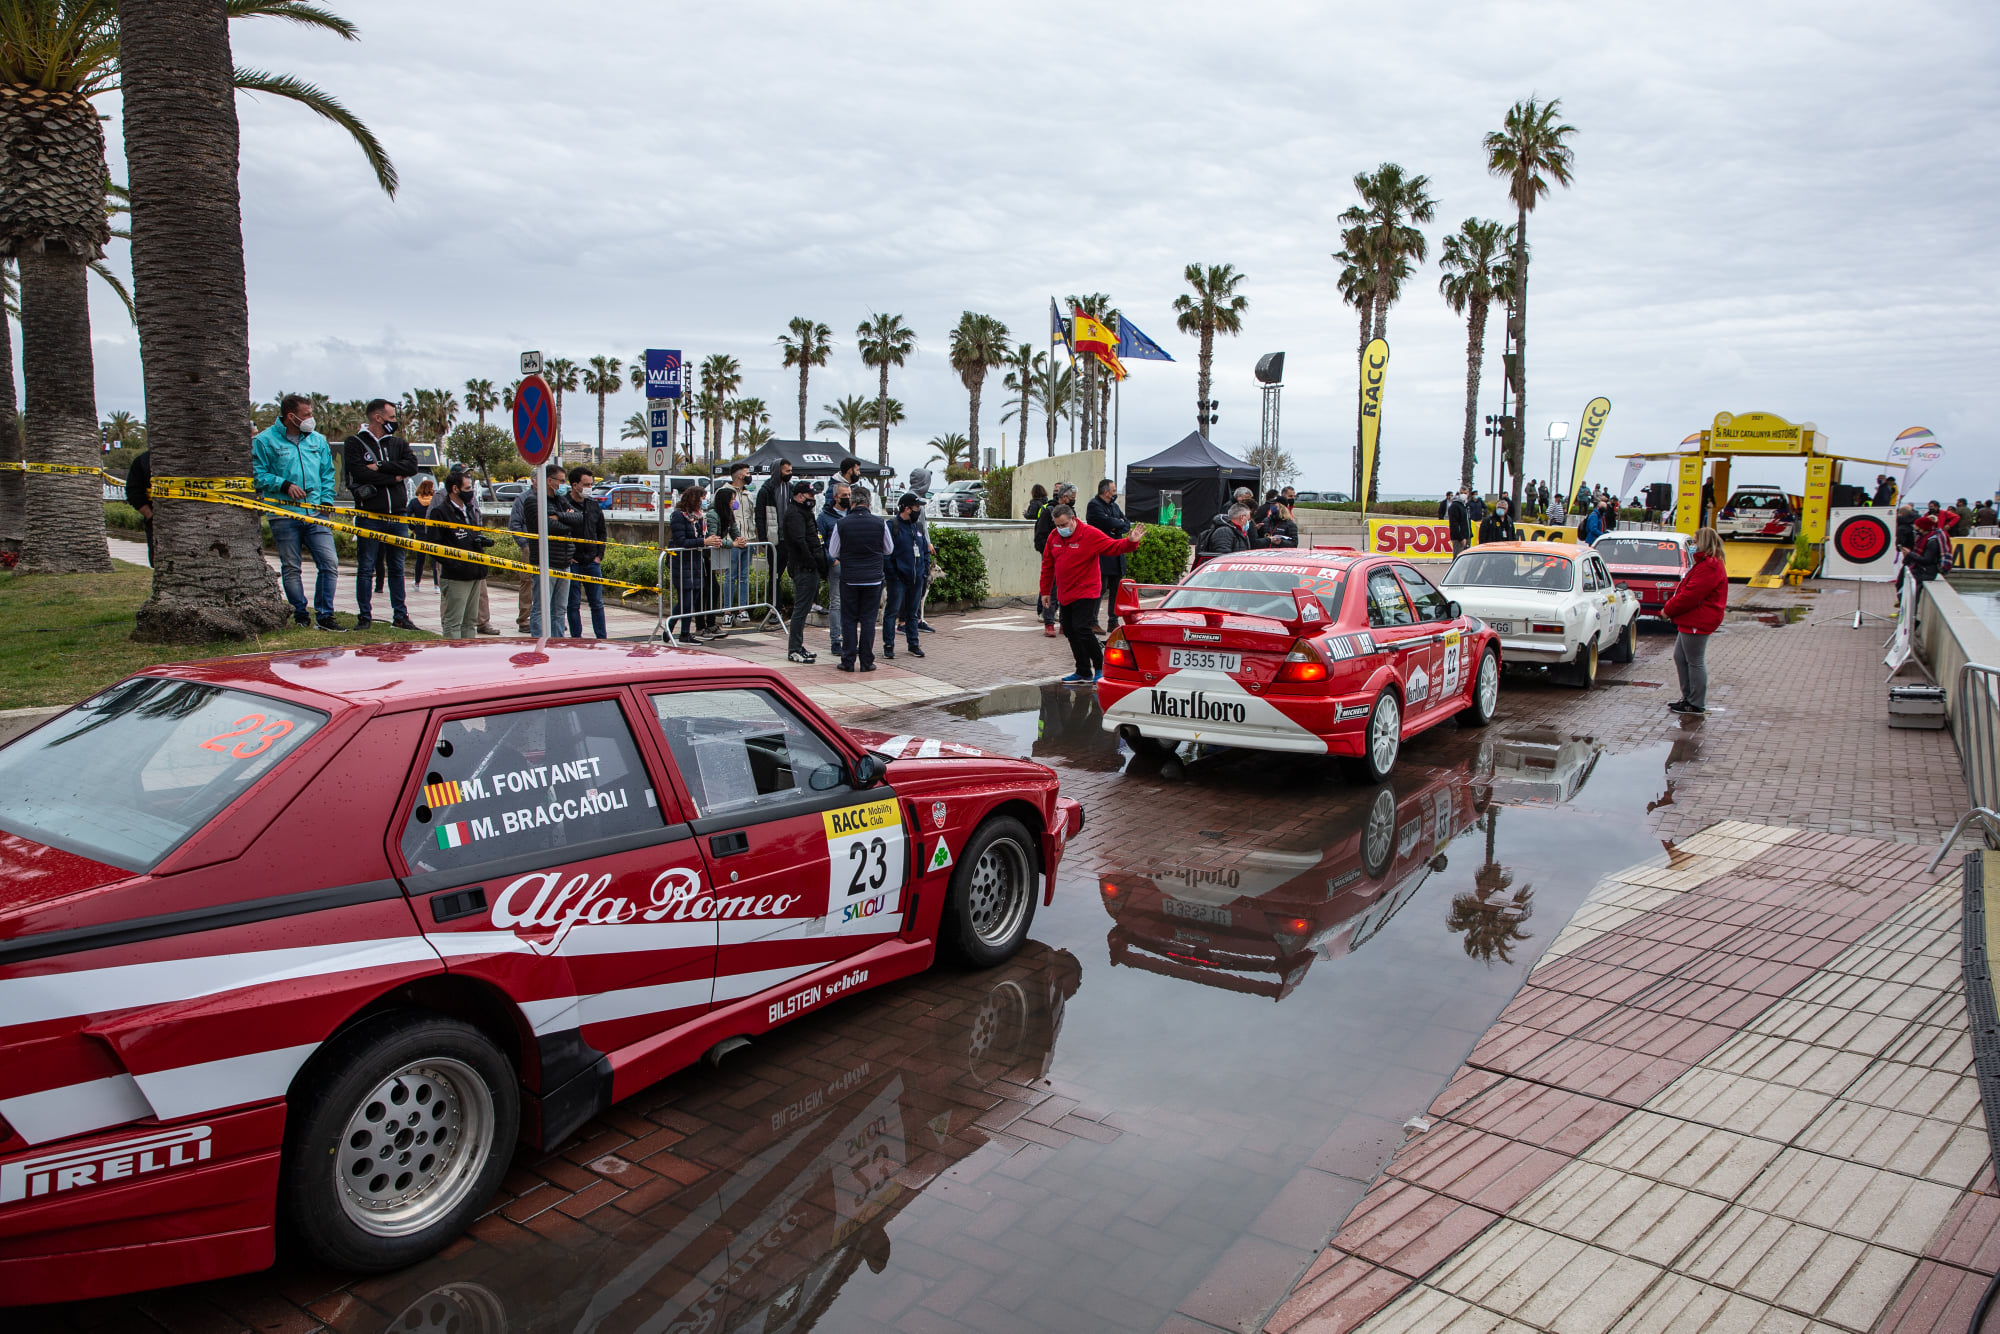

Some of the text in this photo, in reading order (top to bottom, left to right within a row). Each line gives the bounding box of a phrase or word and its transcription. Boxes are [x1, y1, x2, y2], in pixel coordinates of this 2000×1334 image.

[1363, 354, 1385, 417] RACC
[1580, 406, 1607, 447] RACC
[1722, 428, 1740, 438] RALLY
[1740, 430, 1771, 439] CATALUNYA
[184, 480, 215, 490] RACC
[224, 479, 247, 489] RACC
[341, 525, 362, 536] RACC
[368, 531, 389, 542] RACC
[394, 536, 414, 548] RACC
[419, 542, 439, 553] RACC
[444, 547, 462, 558] RACC
[467, 552, 485, 563] RACC
[489, 556, 507, 567] RACC
[1376, 525, 1453, 554] SPOR
[1515, 528, 1564, 541] ACC
[1657, 542, 1676, 551] 20
[1228, 563, 1309, 575] MITSUBISHI
[1544, 556, 1568, 570] 21
[1952, 543, 2000, 569] ACC
[1300, 579, 1335, 596] 22
[1191, 633, 1220, 641] MICHELIN
[1327, 633, 1375, 660] RALLI ART
[1172, 652, 1235, 670] B 3535 TU
[1447, 647, 1457, 675] 22
[1406, 678, 1428, 702] Marlboro
[1150, 689, 1246, 723] Marlboro
[1342, 706, 1369, 717] MICHELIN
[199, 713, 294, 759] 23
[461, 778, 491, 802] M.
[492, 756, 600, 796] FONTANET
[471, 788, 629, 841] M. BRACCAIOLI
[831, 808, 868, 834] RACC
[867, 804, 892, 816] Mobility
[869, 816, 884, 826] Club
[847, 837, 887, 896] 23
[491, 867, 802, 956] Alfa Romeo
[842, 894, 885, 924] SALOU
[768, 969, 869, 1024] BILSTEIN schön
[0, 1125, 212, 1204] PIRELLI
